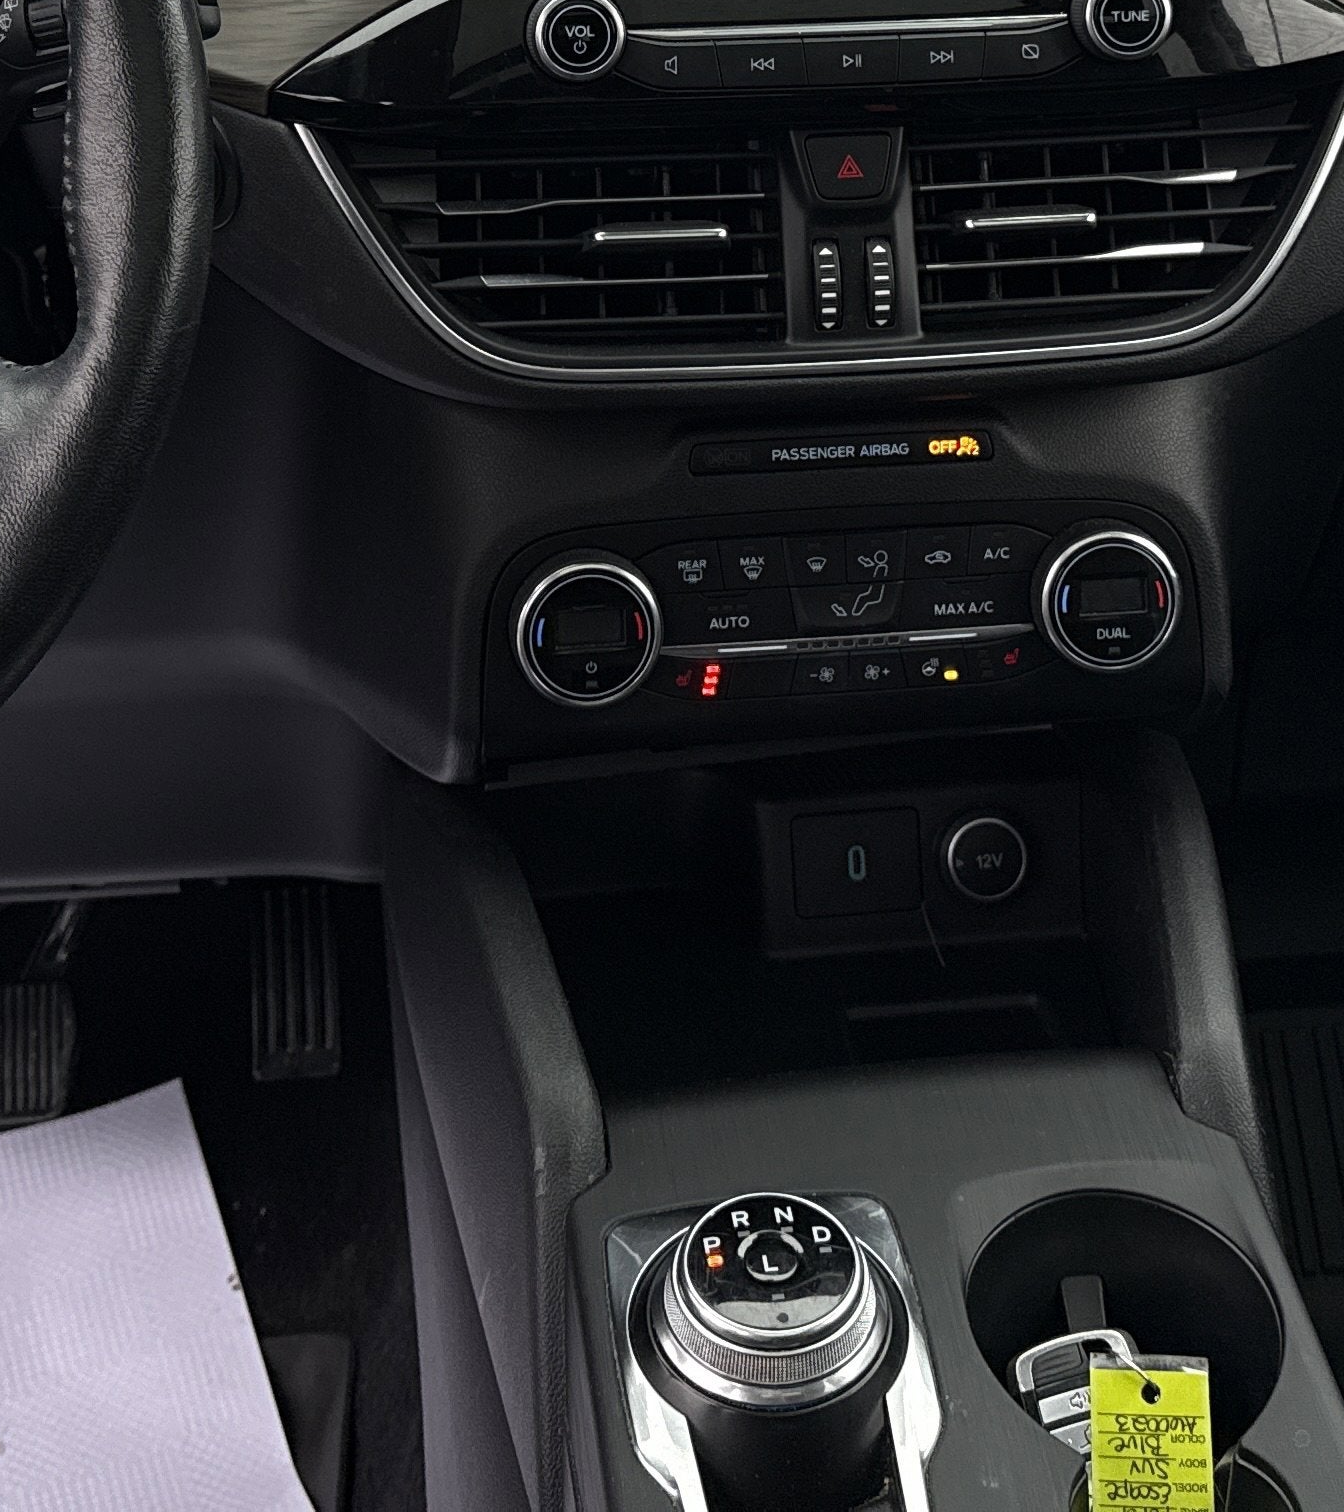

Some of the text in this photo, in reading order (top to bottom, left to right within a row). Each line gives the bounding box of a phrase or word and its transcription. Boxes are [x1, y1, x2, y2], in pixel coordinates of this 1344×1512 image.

[1111, 8, 1150, 24] TUNE
[565, 24, 596, 39] VOL
[771, 445, 855, 462] PASSENGER
[859, 443, 910, 457] AIRBAG
[928, 439, 958, 455] OFF
[739, 555, 765, 567] MAX
[983, 546, 1010, 561] A/C
[678, 558, 708, 571] REAR
[933, 600, 994, 617] MAX A/C
[709, 615, 750, 630] AUTO
[1096, 626, 1131, 640] DUAL
[976, 852, 1003, 869] 12V
[730, 1206, 794, 1228] R N
[702, 1226, 832, 1255] P D
[761, 1254, 779, 1273] L
[1108, 1435, 1170, 1457] Blue
[1170, 1434, 1206, 1445] COLOR
[1178, 1458, 1207, 1469] BODY
[1105, 1480, 1173, 1504] Escape
[1171, 1482, 1208, 1494] MODEL
